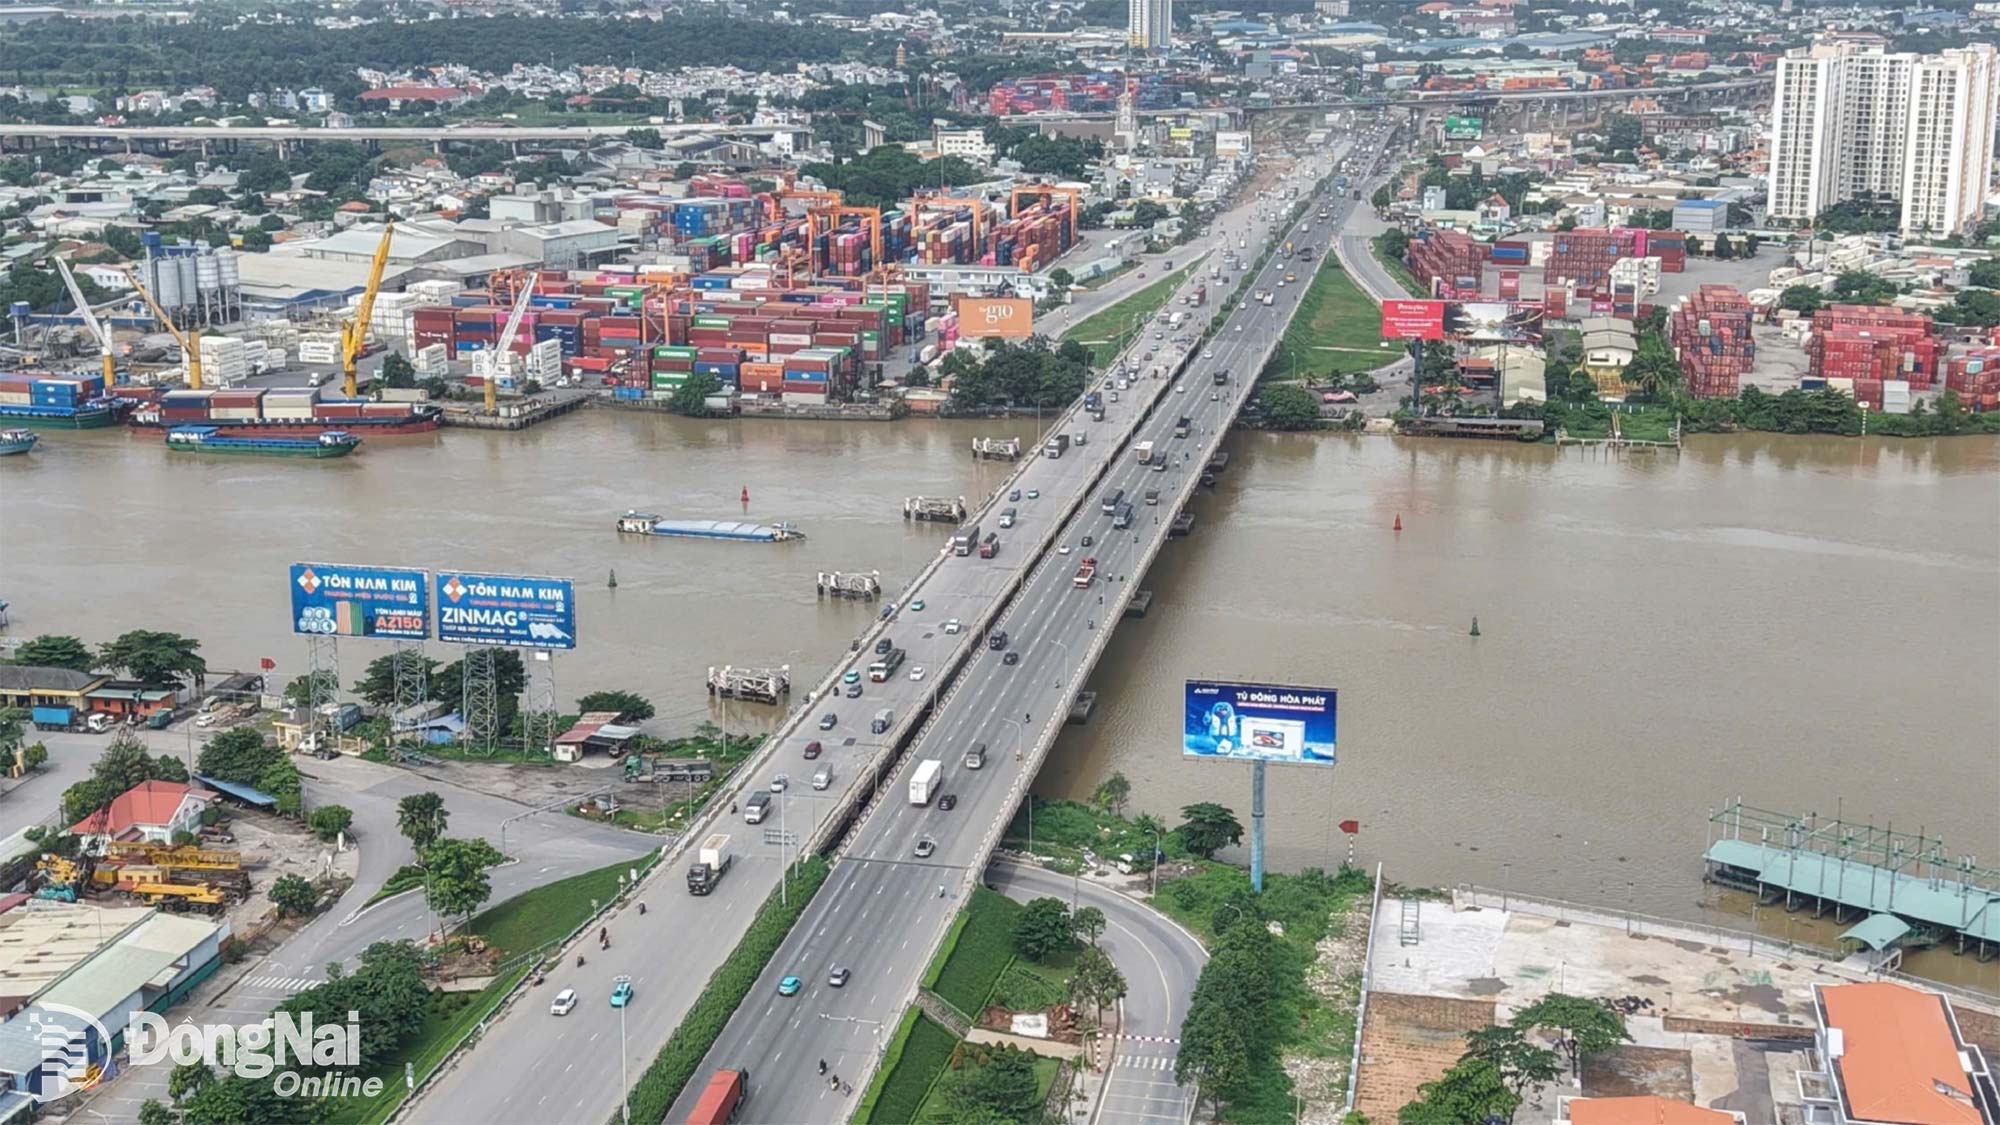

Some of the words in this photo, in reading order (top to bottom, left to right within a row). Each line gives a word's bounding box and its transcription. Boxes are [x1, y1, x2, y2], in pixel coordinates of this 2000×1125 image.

[322, 574, 351, 588] TÔN
[355, 577, 387, 590] NAM
[391, 579, 417, 591] KIM
[467, 582, 497, 595] TÔN
[501, 586, 534, 598] NAM
[538, 588, 564, 601] KIM
[375, 616, 423, 629] AZ150
[441, 607, 518, 626] ZINMAG
[1250, 692, 1277, 702] ĐÔNG
[1280, 694, 1300, 704] HÒA
[1302, 696, 1326, 705] PHÁT
